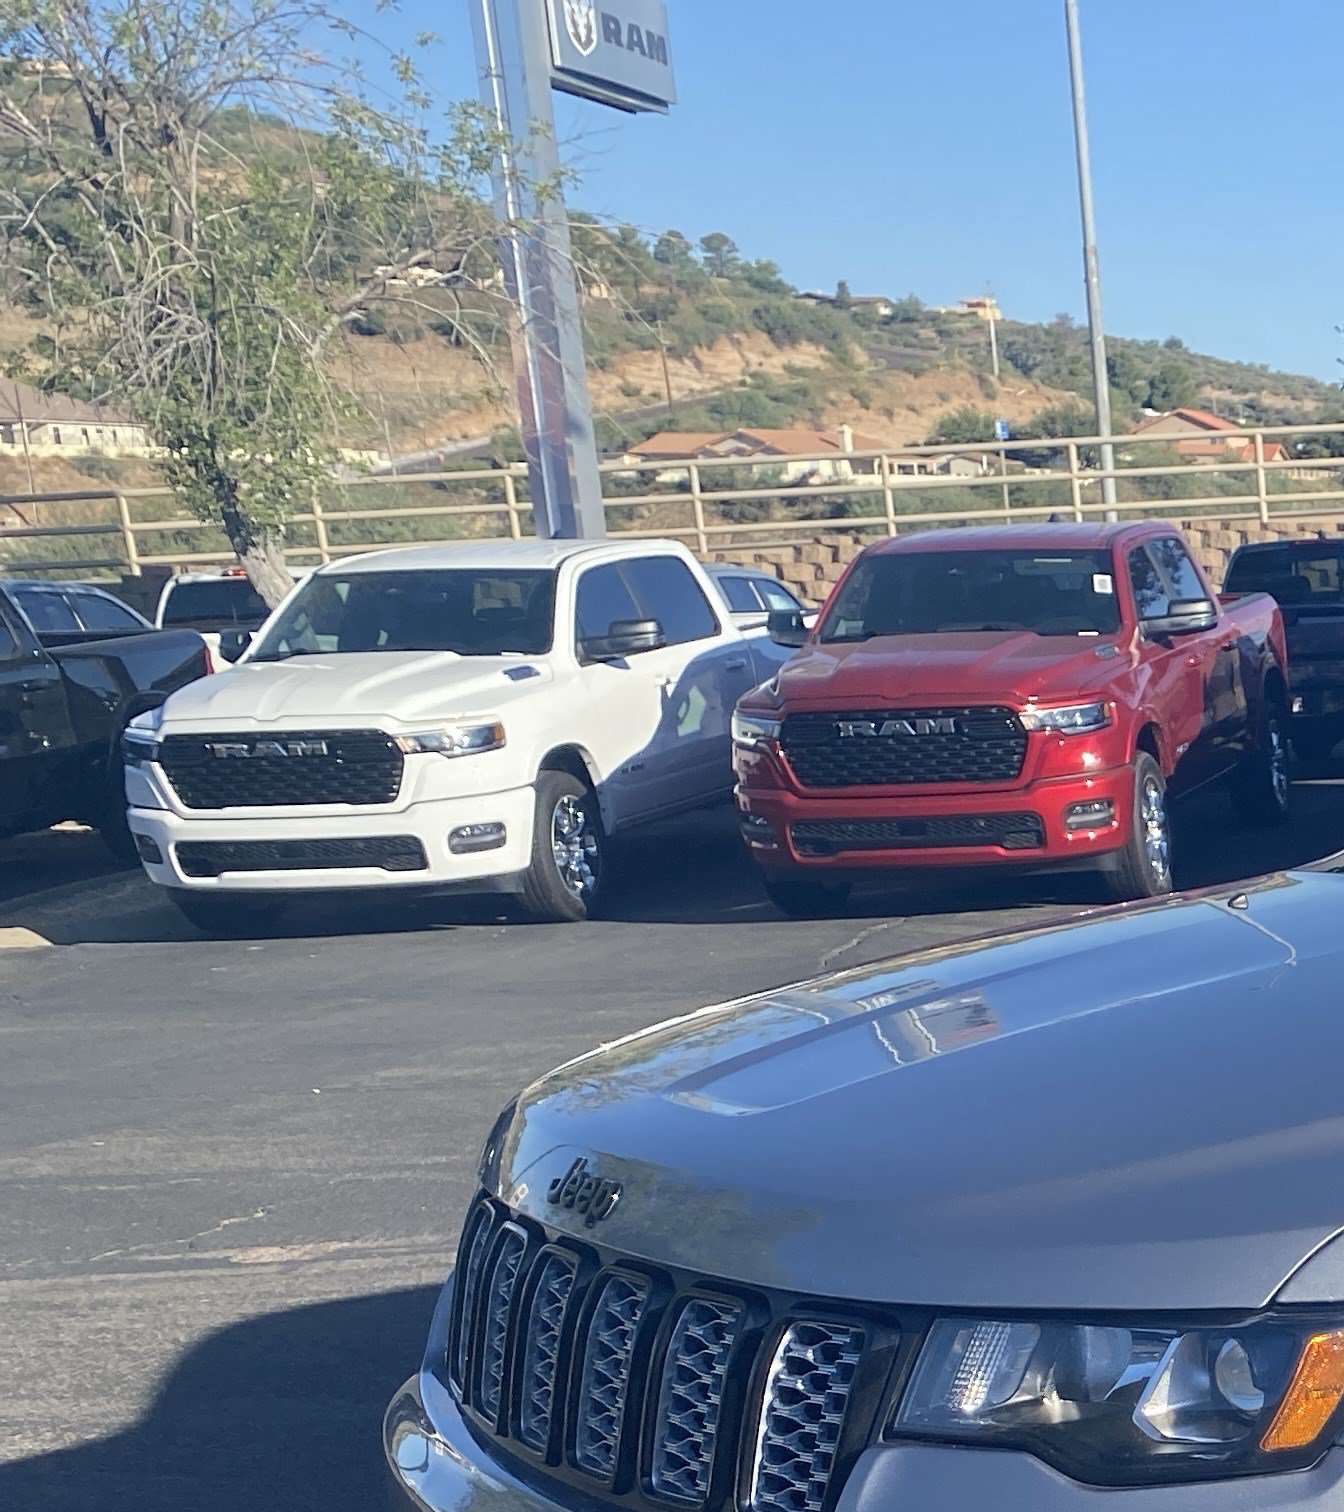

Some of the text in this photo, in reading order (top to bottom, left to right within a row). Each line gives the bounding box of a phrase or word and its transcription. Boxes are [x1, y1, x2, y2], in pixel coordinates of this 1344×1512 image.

[600, 11, 668, 66] RAM
[837, 716, 957, 738] RAM
[210, 739, 328, 759] RAM
[547, 1157, 623, 1229] Jeep
